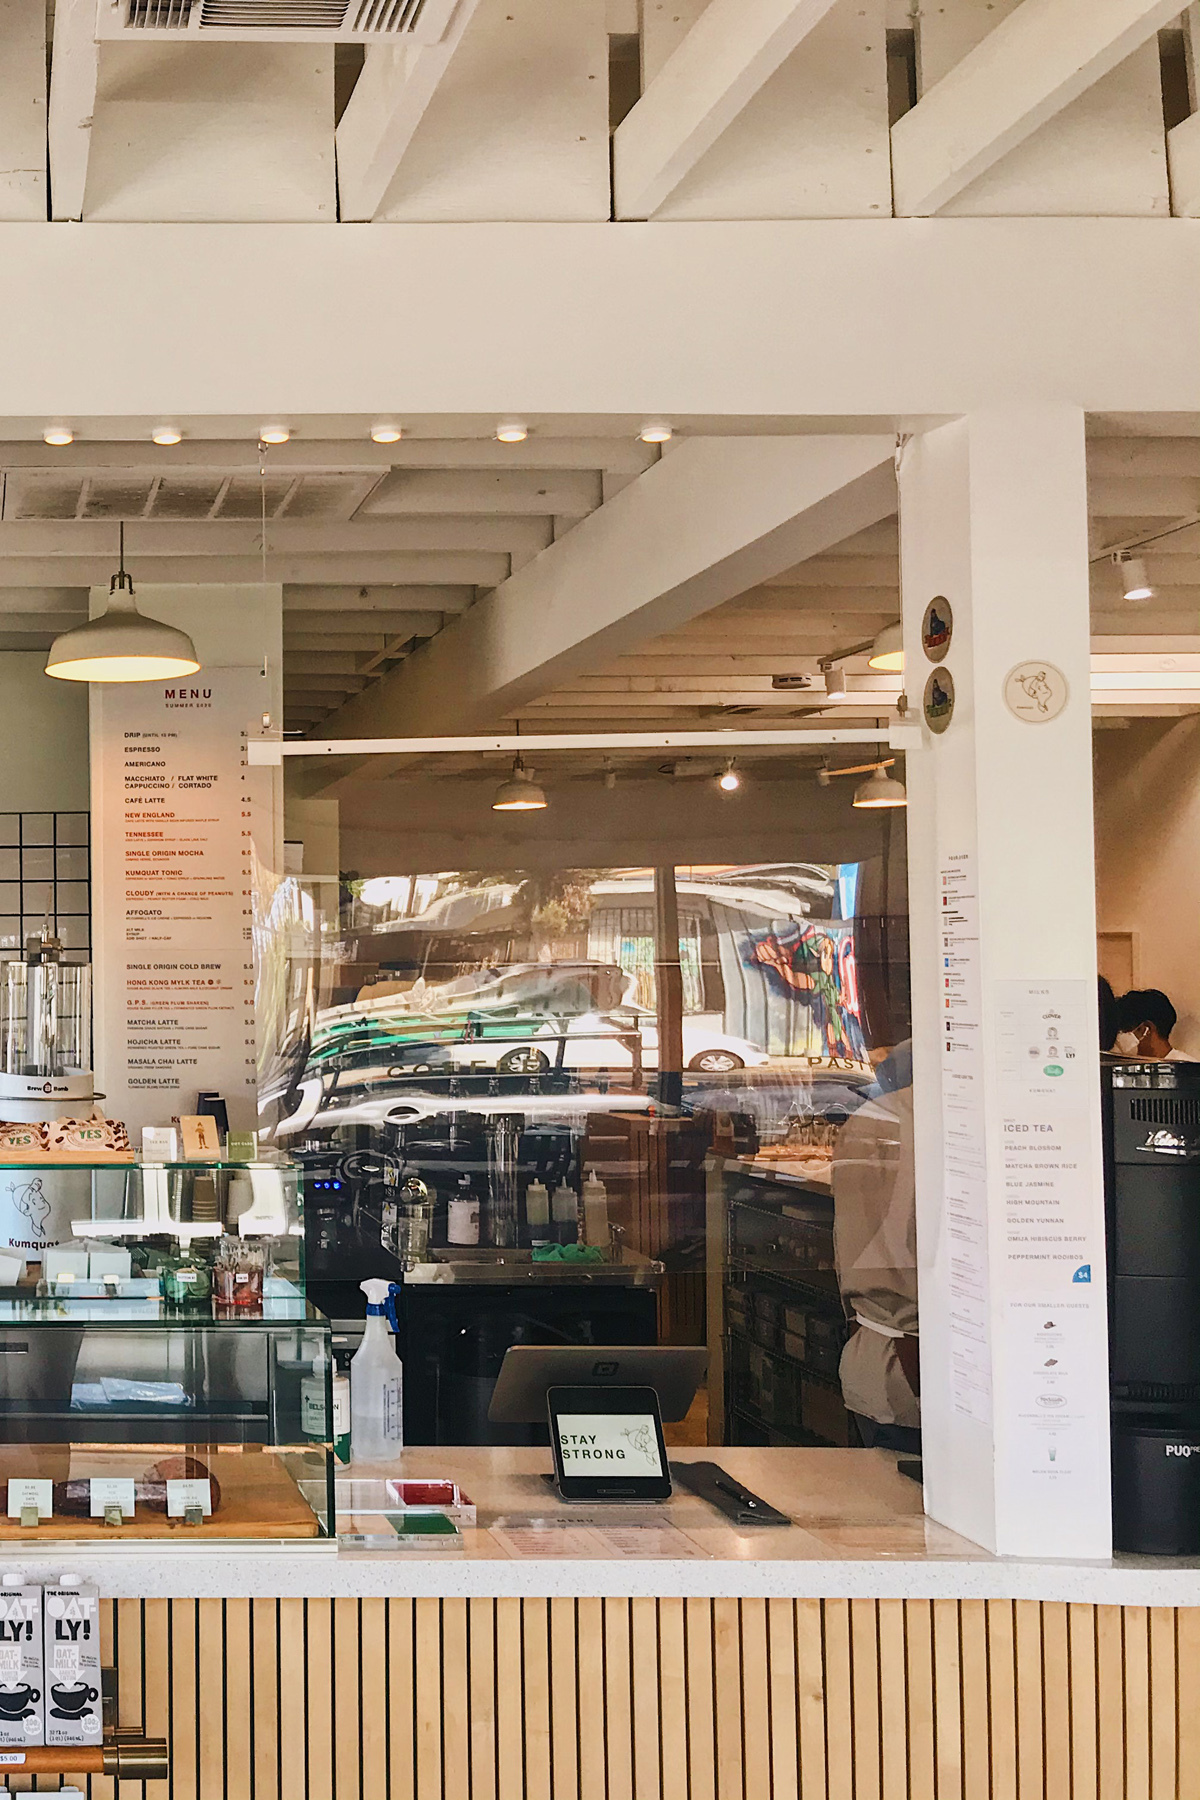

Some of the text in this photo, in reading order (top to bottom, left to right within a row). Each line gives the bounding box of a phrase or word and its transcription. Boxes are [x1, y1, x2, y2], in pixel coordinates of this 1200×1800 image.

[165, 689, 212, 699] MENU
[79, 1127, 102, 1139] YES
[9, 1136, 31, 1145] YES
[560, 1435, 596, 1445] STAY
[562, 1449, 626, 1460] STRONG
[55, 1619, 90, 1640] LY!
[55, 1659, 77, 1669] MILK
